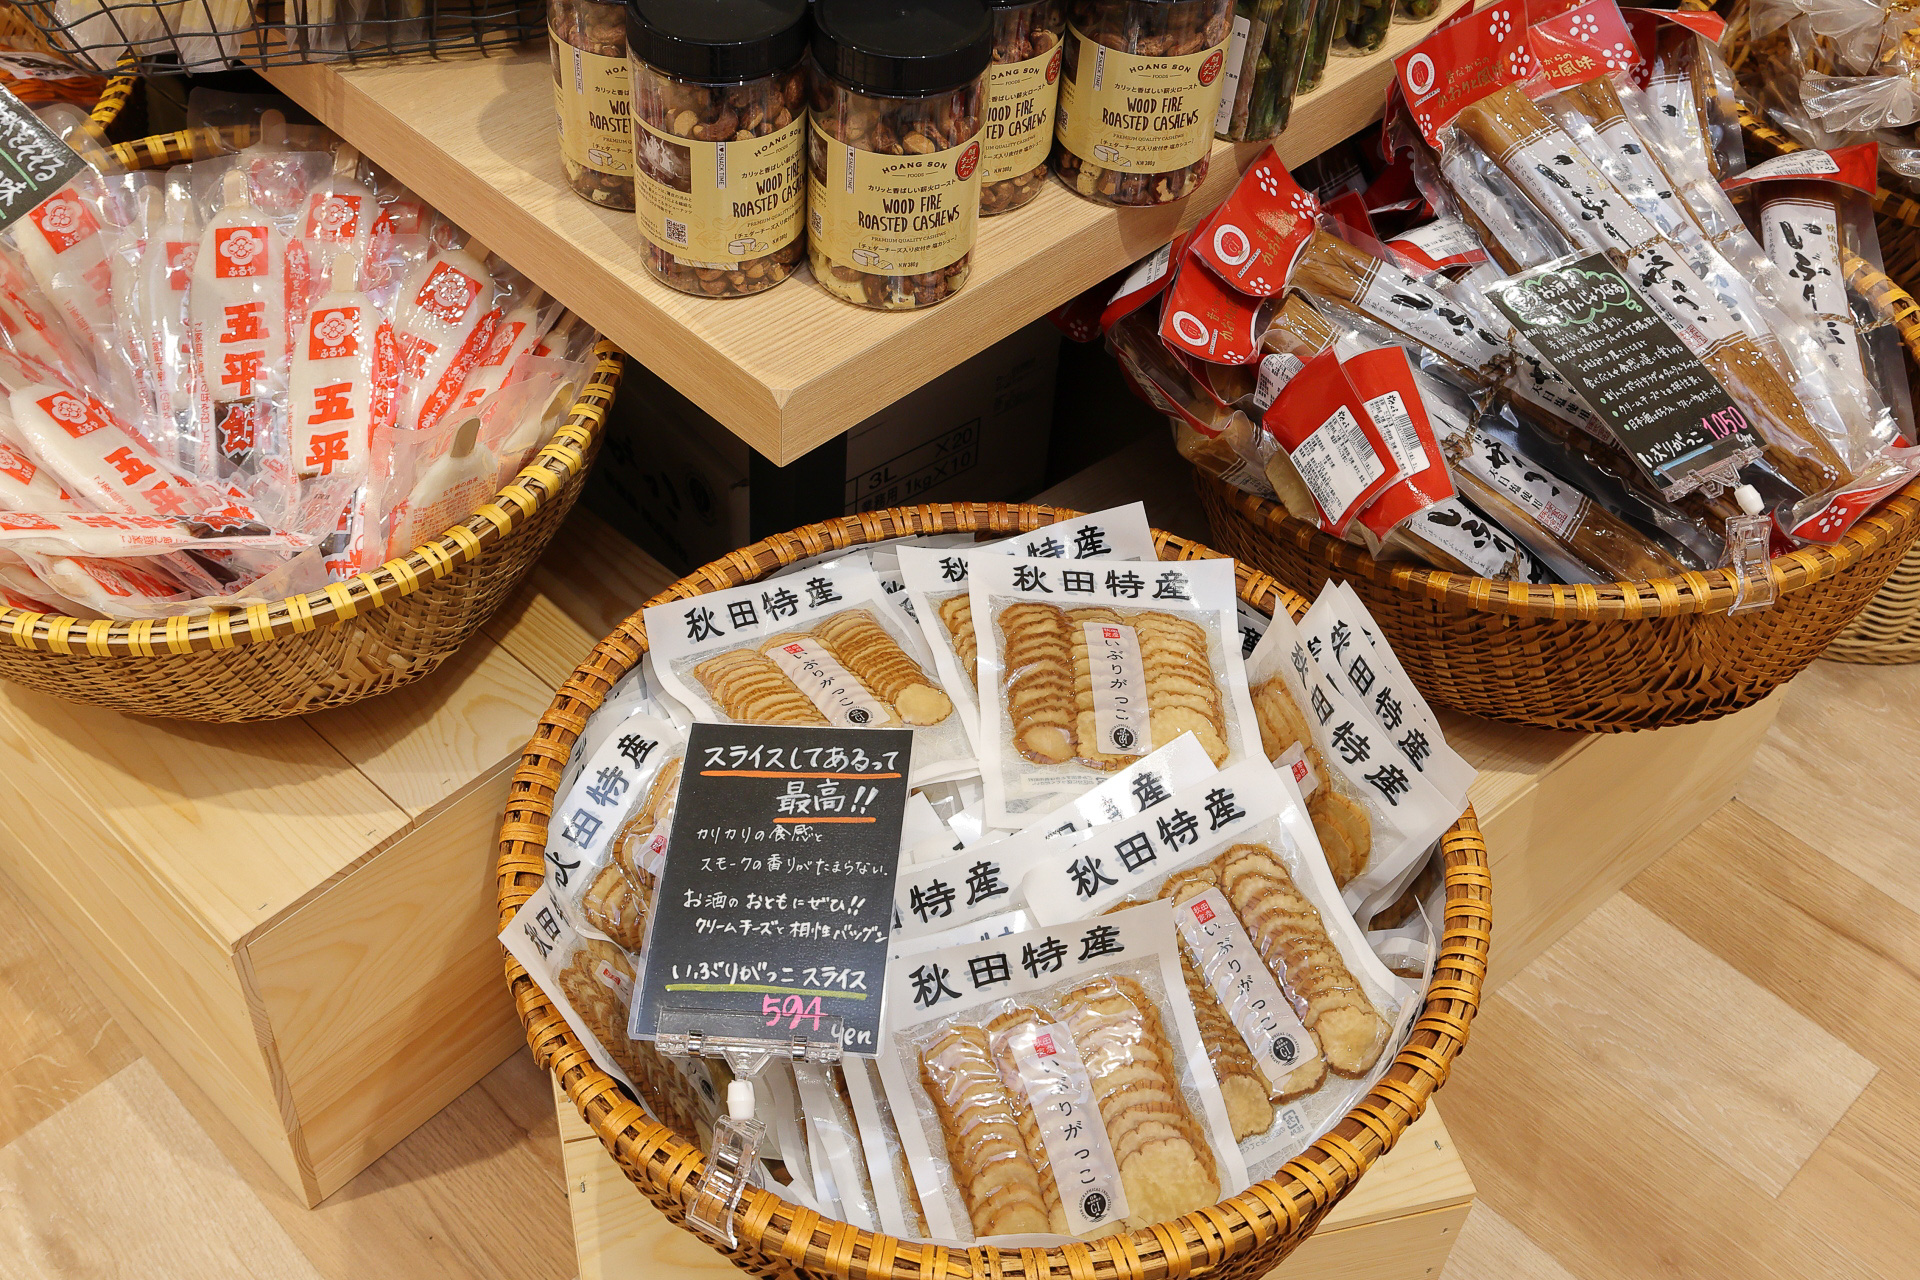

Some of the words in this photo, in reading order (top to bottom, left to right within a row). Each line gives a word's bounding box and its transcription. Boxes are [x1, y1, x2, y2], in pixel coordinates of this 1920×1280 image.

[1022, 67, 1040, 75] SON
[1129, 63, 1168, 74] HOANG
[1171, 63, 1192, 74] SON
[1114, 83, 1199, 95] カリッと香ばしい薪火ロースト
[1015, 97, 1035, 117] FIRE
[1127, 97, 1157, 114] WOOD
[1161, 96, 1184, 113] FIRE
[589, 111, 632, 134] ROASTE
[1008, 108, 1047, 138] CASHEWS
[1102, 108, 1149, 132] ROASTED
[1153, 108, 1199, 132] CASHEWS
[753, 134, 788, 158] HOANG
[755, 172, 783, 196] WOOD
[785, 158, 801, 185] FIRE
[881, 162, 923, 175] HOANG
[927, 161, 948, 171] SON
[867, 179, 957, 195] カリッと香ばしい薪火ロースト
[732, 194, 779, 219] ROASTED
[882, 198, 915, 215] WOOD
[920, 192, 943, 210] FIRE
[858, 210, 908, 233] ROASTED
[912, 204, 960, 232] CASHEWS
[871, 236, 898, 244] PREMIUM
[898, 236, 923, 244] QUALITY
[923, 230, 947, 241] CASHEWS
[228, 265, 257, 277] ふるや
[320, 347, 347, 358] ふるや
[1530, 381, 1592, 422] 天日塩使用
[76, 420, 99, 435] ふるや
[1636, 430, 1705, 469] いぶりがっこ
[869, 467, 898, 490] 3L
[1487, 465, 1545, 511] 天日塩使用
[1012, 564, 1191, 602] 秋田特産
[683, 576, 843, 643] 秋田特産
[794, 652, 855, 708] いぶりがっこ
[1104, 639, 1130, 721] いぶりがっこ
[1330, 619, 1432, 773] 秋田特産
[1290, 640, 1411, 807] 秋田特産
[703, 744, 900, 773] スライスしてあるって
[775, 778, 880, 816] 最高!!
[696, 824, 823, 844] カリカリの食感と
[1065, 786, 1248, 900] 秋田特産
[671, 961, 796, 986] いぶりがっこ
[802, 965, 868, 991] スライス
[908, 924, 1126, 1008] 秋田特産
[1203, 921, 1281, 1035] いぶりがっこ
[761, 993, 829, 1031] 594
[830, 1022, 872, 1047] yen
[1279, 1046, 1292, 1058] GI
[1043, 1059, 1097, 1185] いぶりがっこ
[1090, 1202, 1101, 1215] GI
